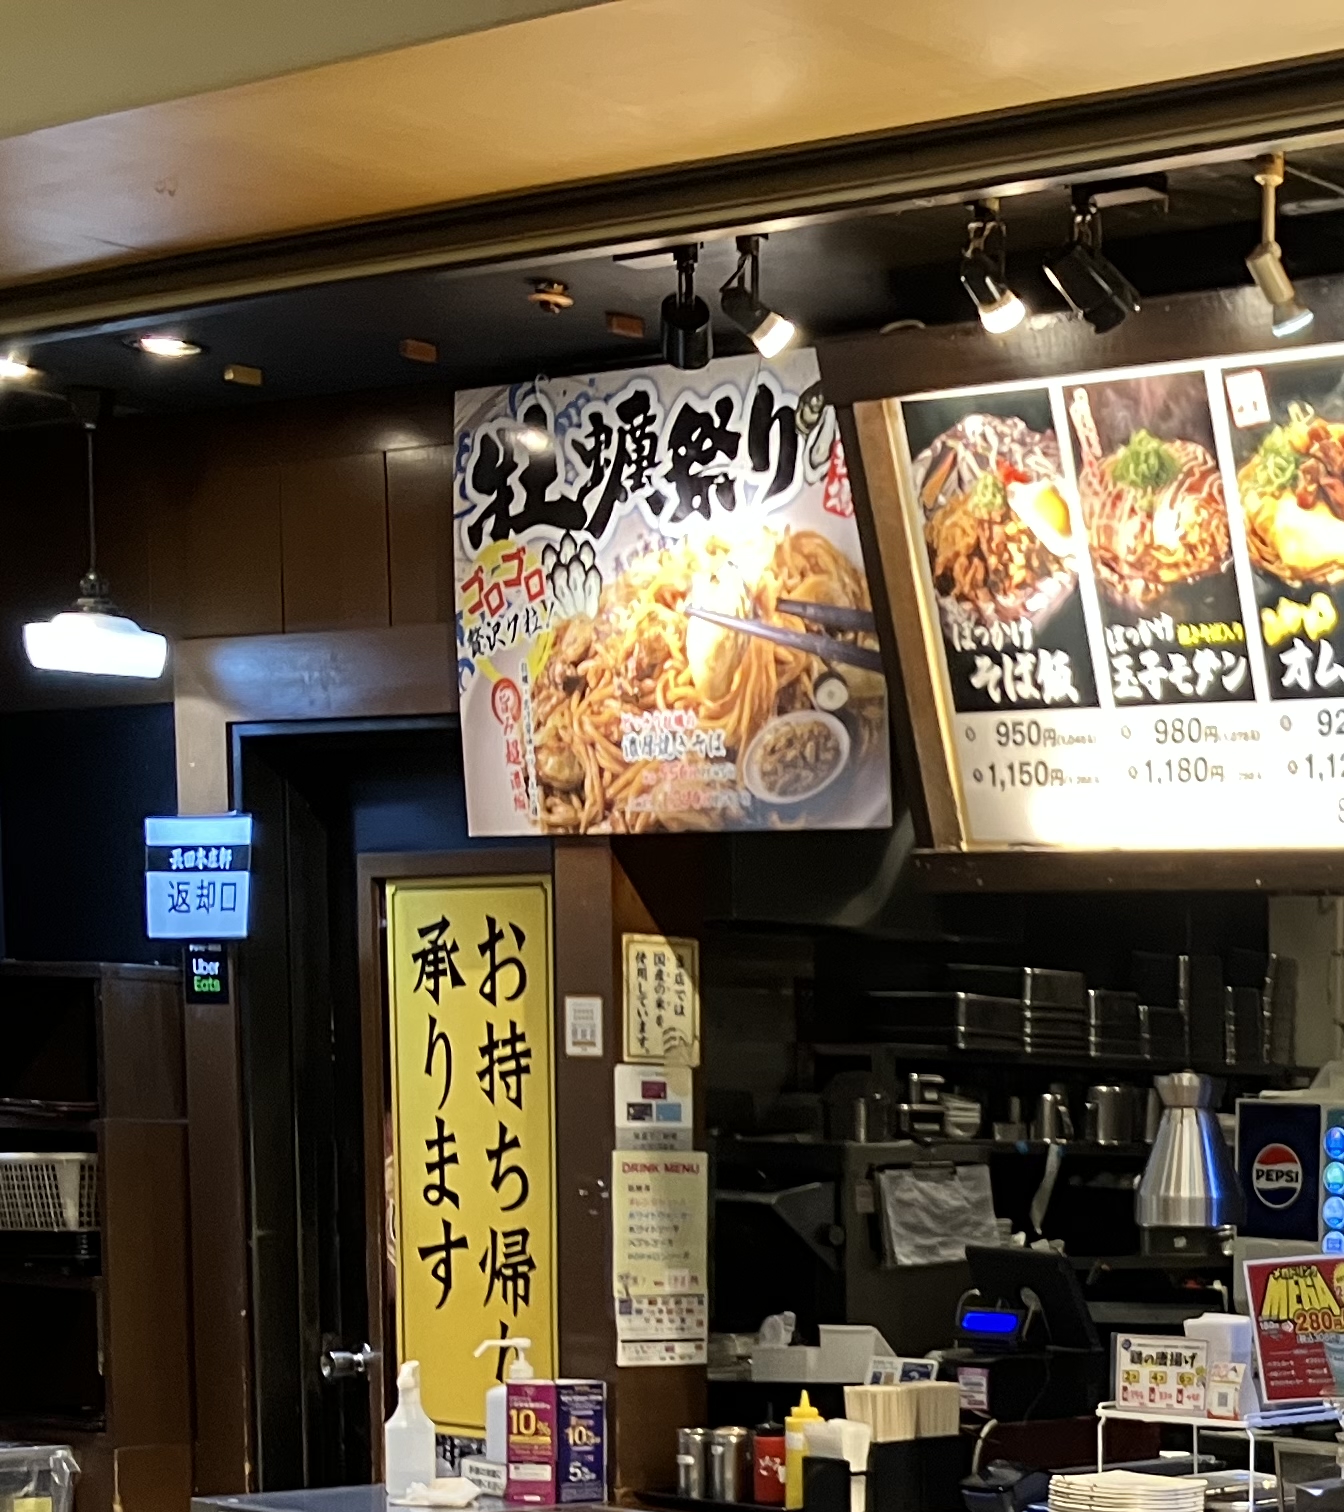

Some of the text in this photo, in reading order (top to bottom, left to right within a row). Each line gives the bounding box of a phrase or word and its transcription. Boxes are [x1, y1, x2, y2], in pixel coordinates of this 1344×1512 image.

[461, 547, 546, 618] ゴロゴロ
[970, 648, 1080, 704] そば飯
[1111, 648, 1248, 701] 玉子モダン
[167, 878, 237, 915] 返却口
[192, 958, 220, 976] Uber
[193, 975, 221, 993] Eats
[411, 914, 470, 1311] 承ります
[621, 1162, 700, 1175] DRINK MENU
[1255, 1168, 1300, 1184] PEPSI
[1260, 1274, 1342, 1321] MEGA
[1129, 1349, 1198, 1369] 鶏の唐揚げ
